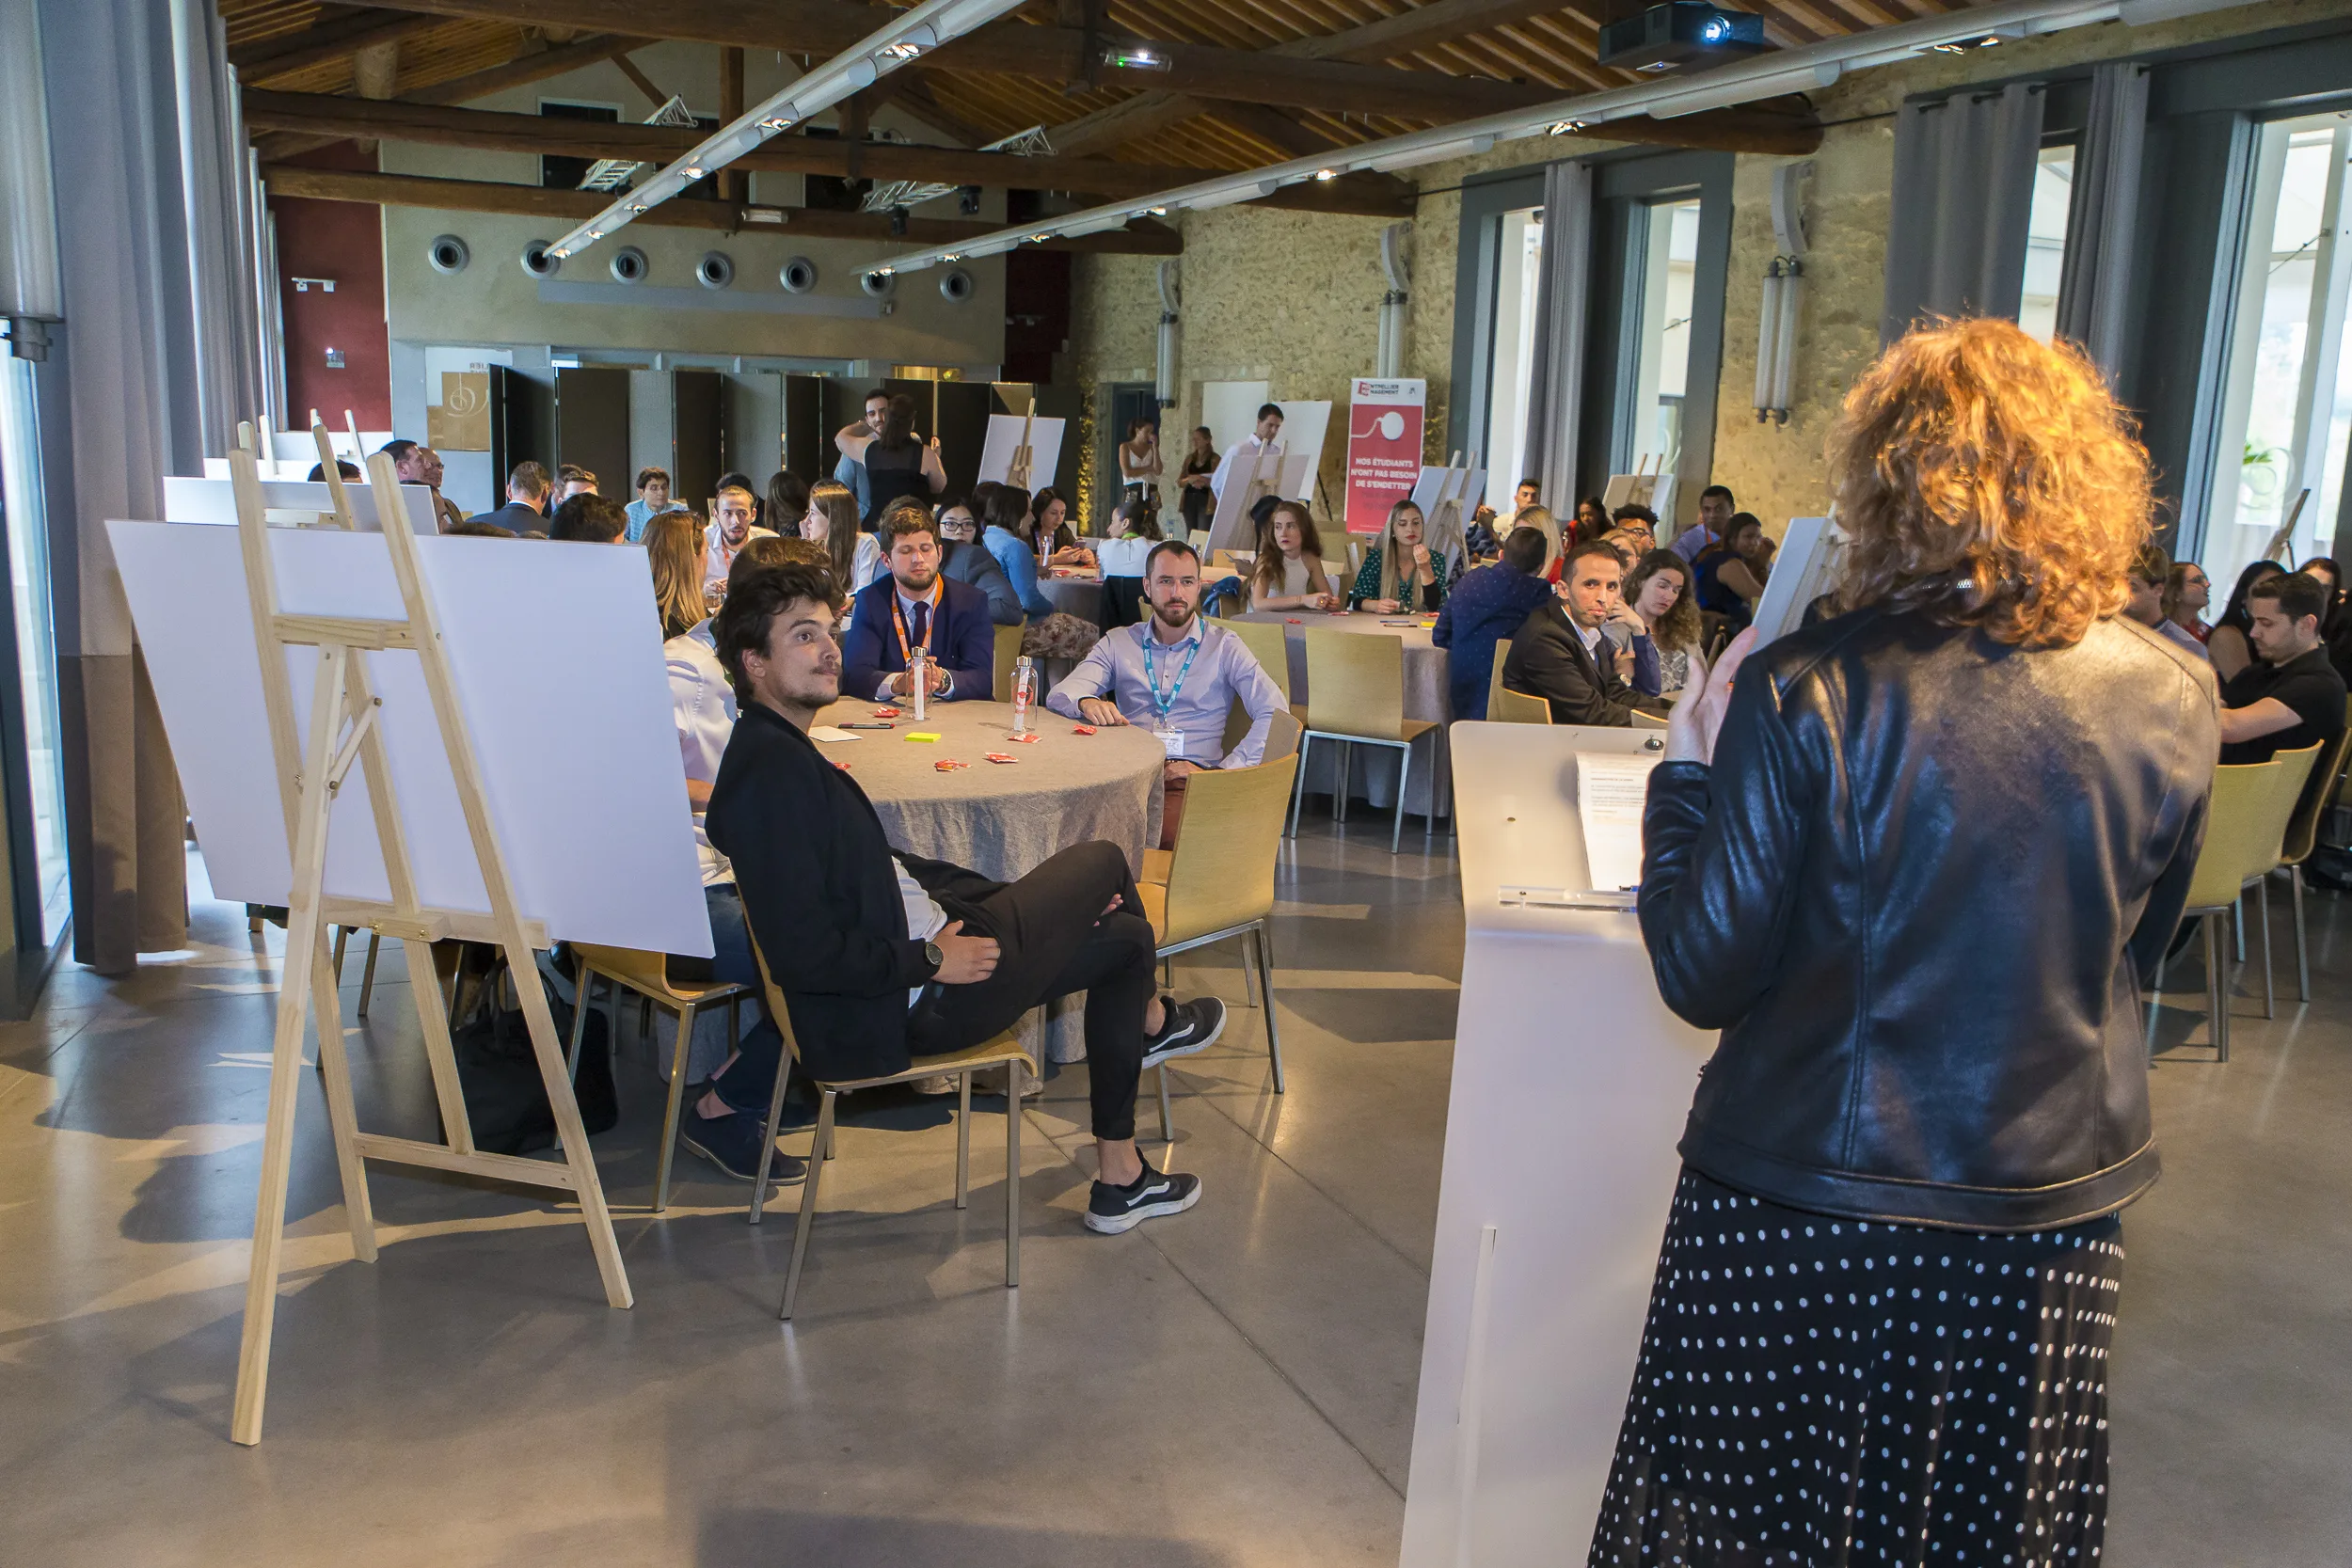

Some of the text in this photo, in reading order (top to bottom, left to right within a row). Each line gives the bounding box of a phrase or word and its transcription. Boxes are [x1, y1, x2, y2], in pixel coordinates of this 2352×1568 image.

[1373, 457, 1413, 467] ÉTUDIANTS
[1351, 468, 1373, 477] N'ONT
[1367, 481, 1411, 490] S'ENDETTER
